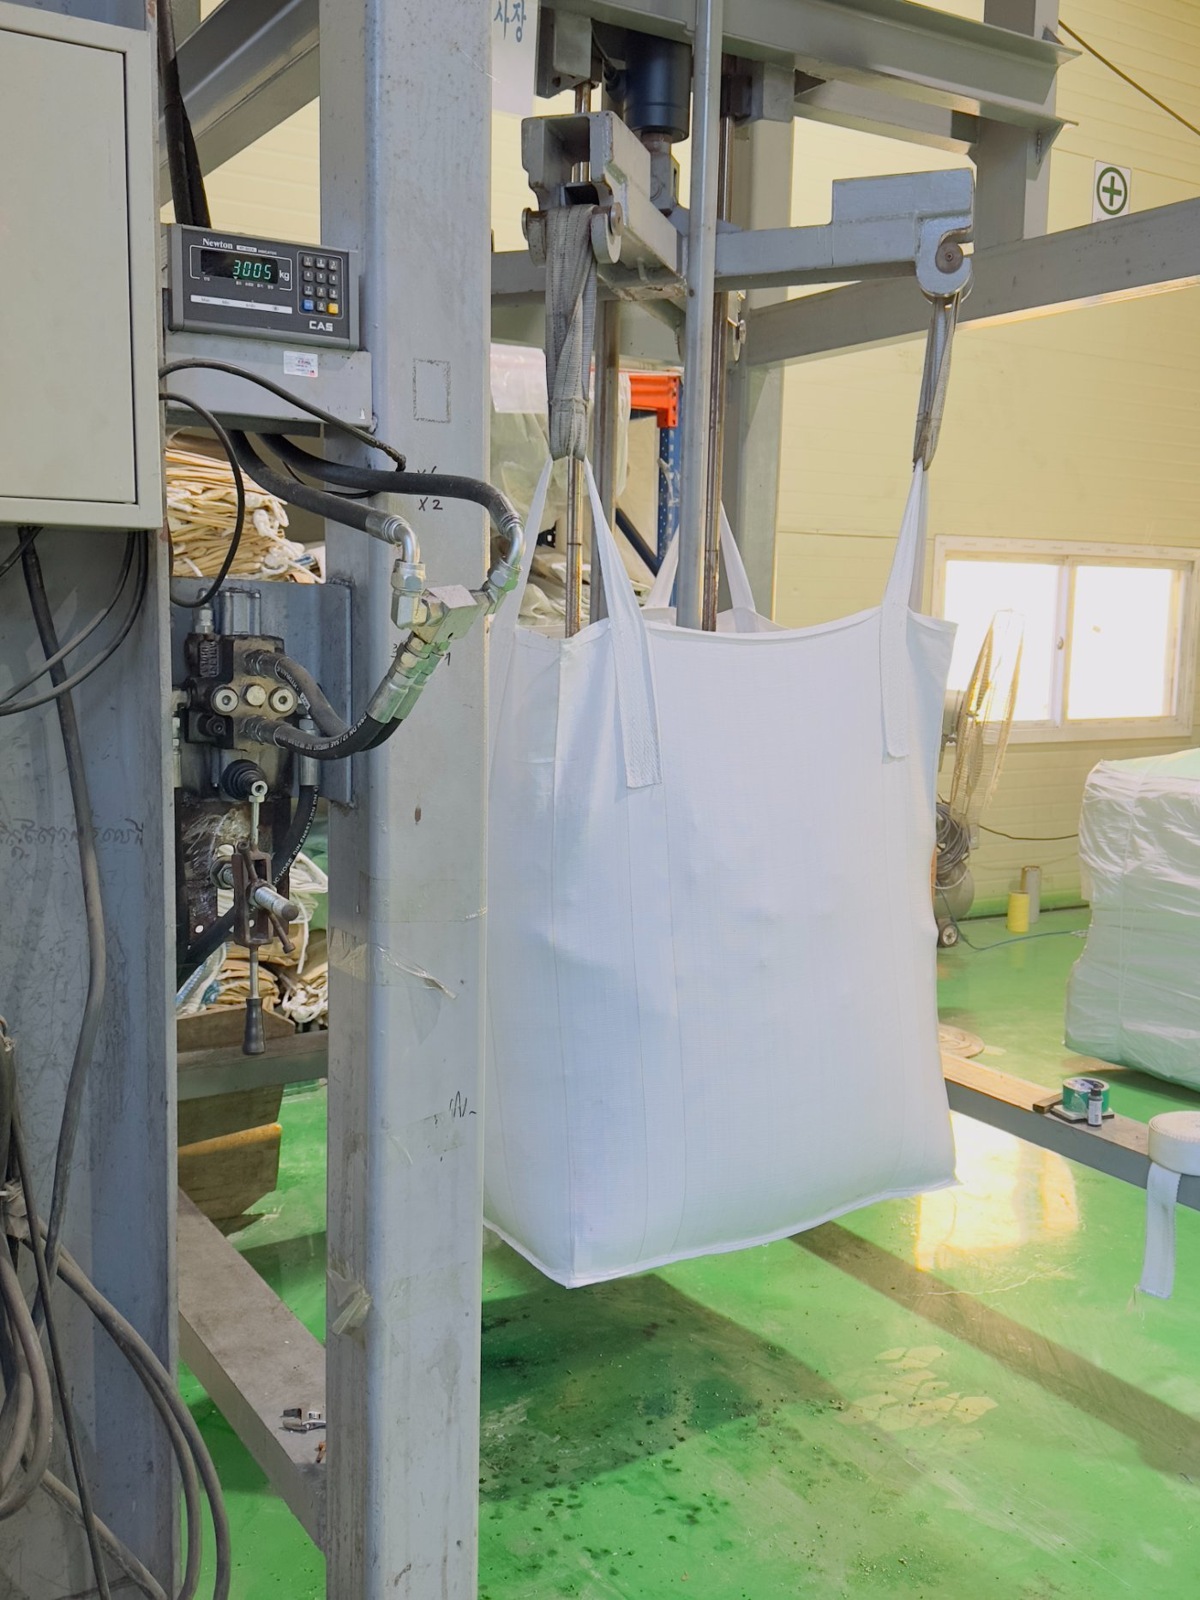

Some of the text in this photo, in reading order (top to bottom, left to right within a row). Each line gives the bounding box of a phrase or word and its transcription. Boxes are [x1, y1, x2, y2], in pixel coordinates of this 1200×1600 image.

[202, 238, 234, 250] Newton
[233, 259, 272, 280] 3005
[279, 270, 290, 282] kg
[309, 320, 334, 332] CAS
[279, 858, 293, 877] HOSE
[292, 843, 301, 856] DIN
